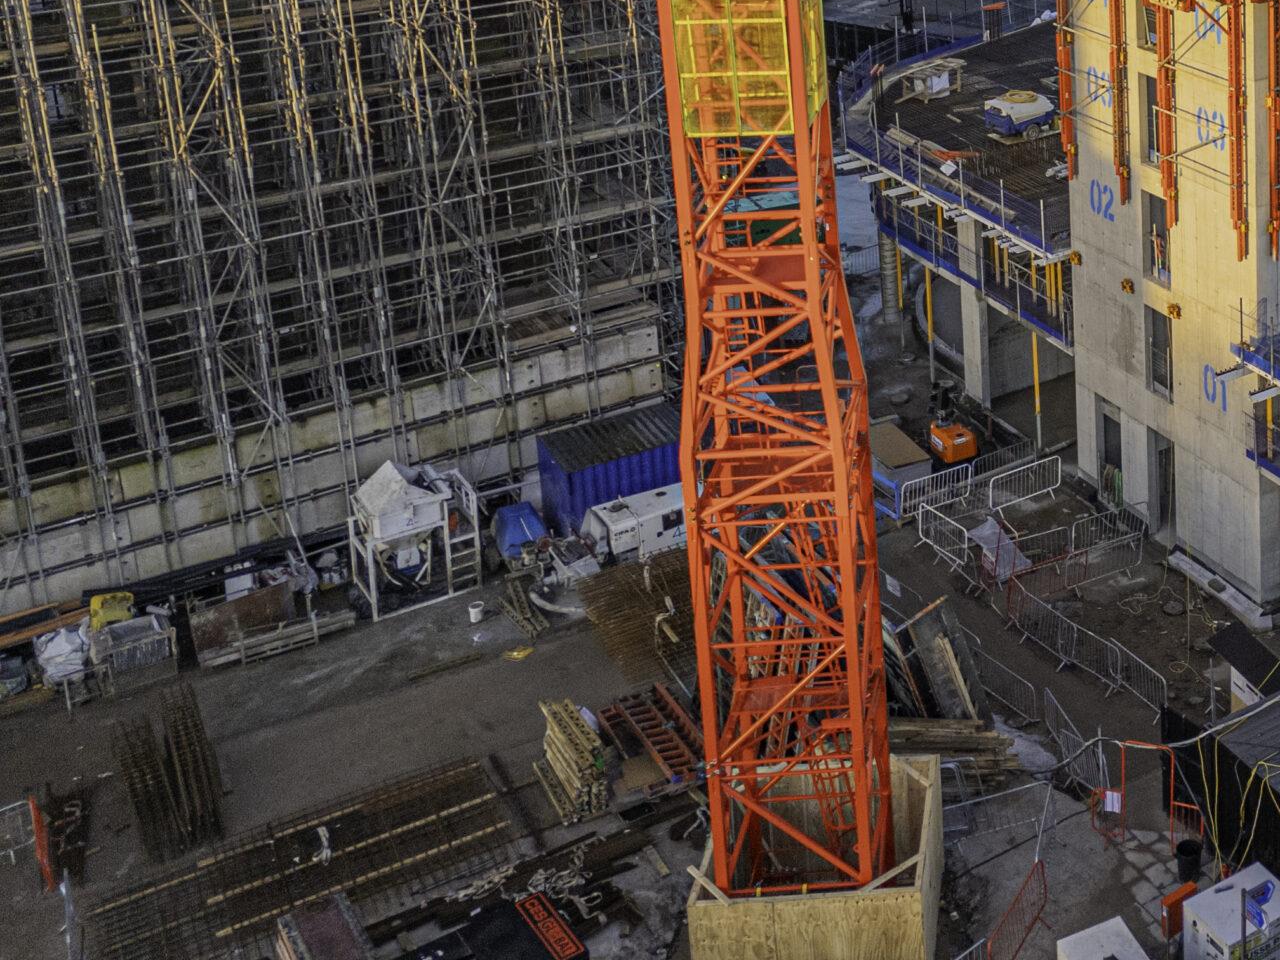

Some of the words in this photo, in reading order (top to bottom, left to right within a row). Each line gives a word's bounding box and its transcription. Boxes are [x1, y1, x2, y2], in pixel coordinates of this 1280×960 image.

[1196, 106, 1226, 151] 03
[1089, 178, 1116, 223] 02
[524, 898, 549, 922] CES
